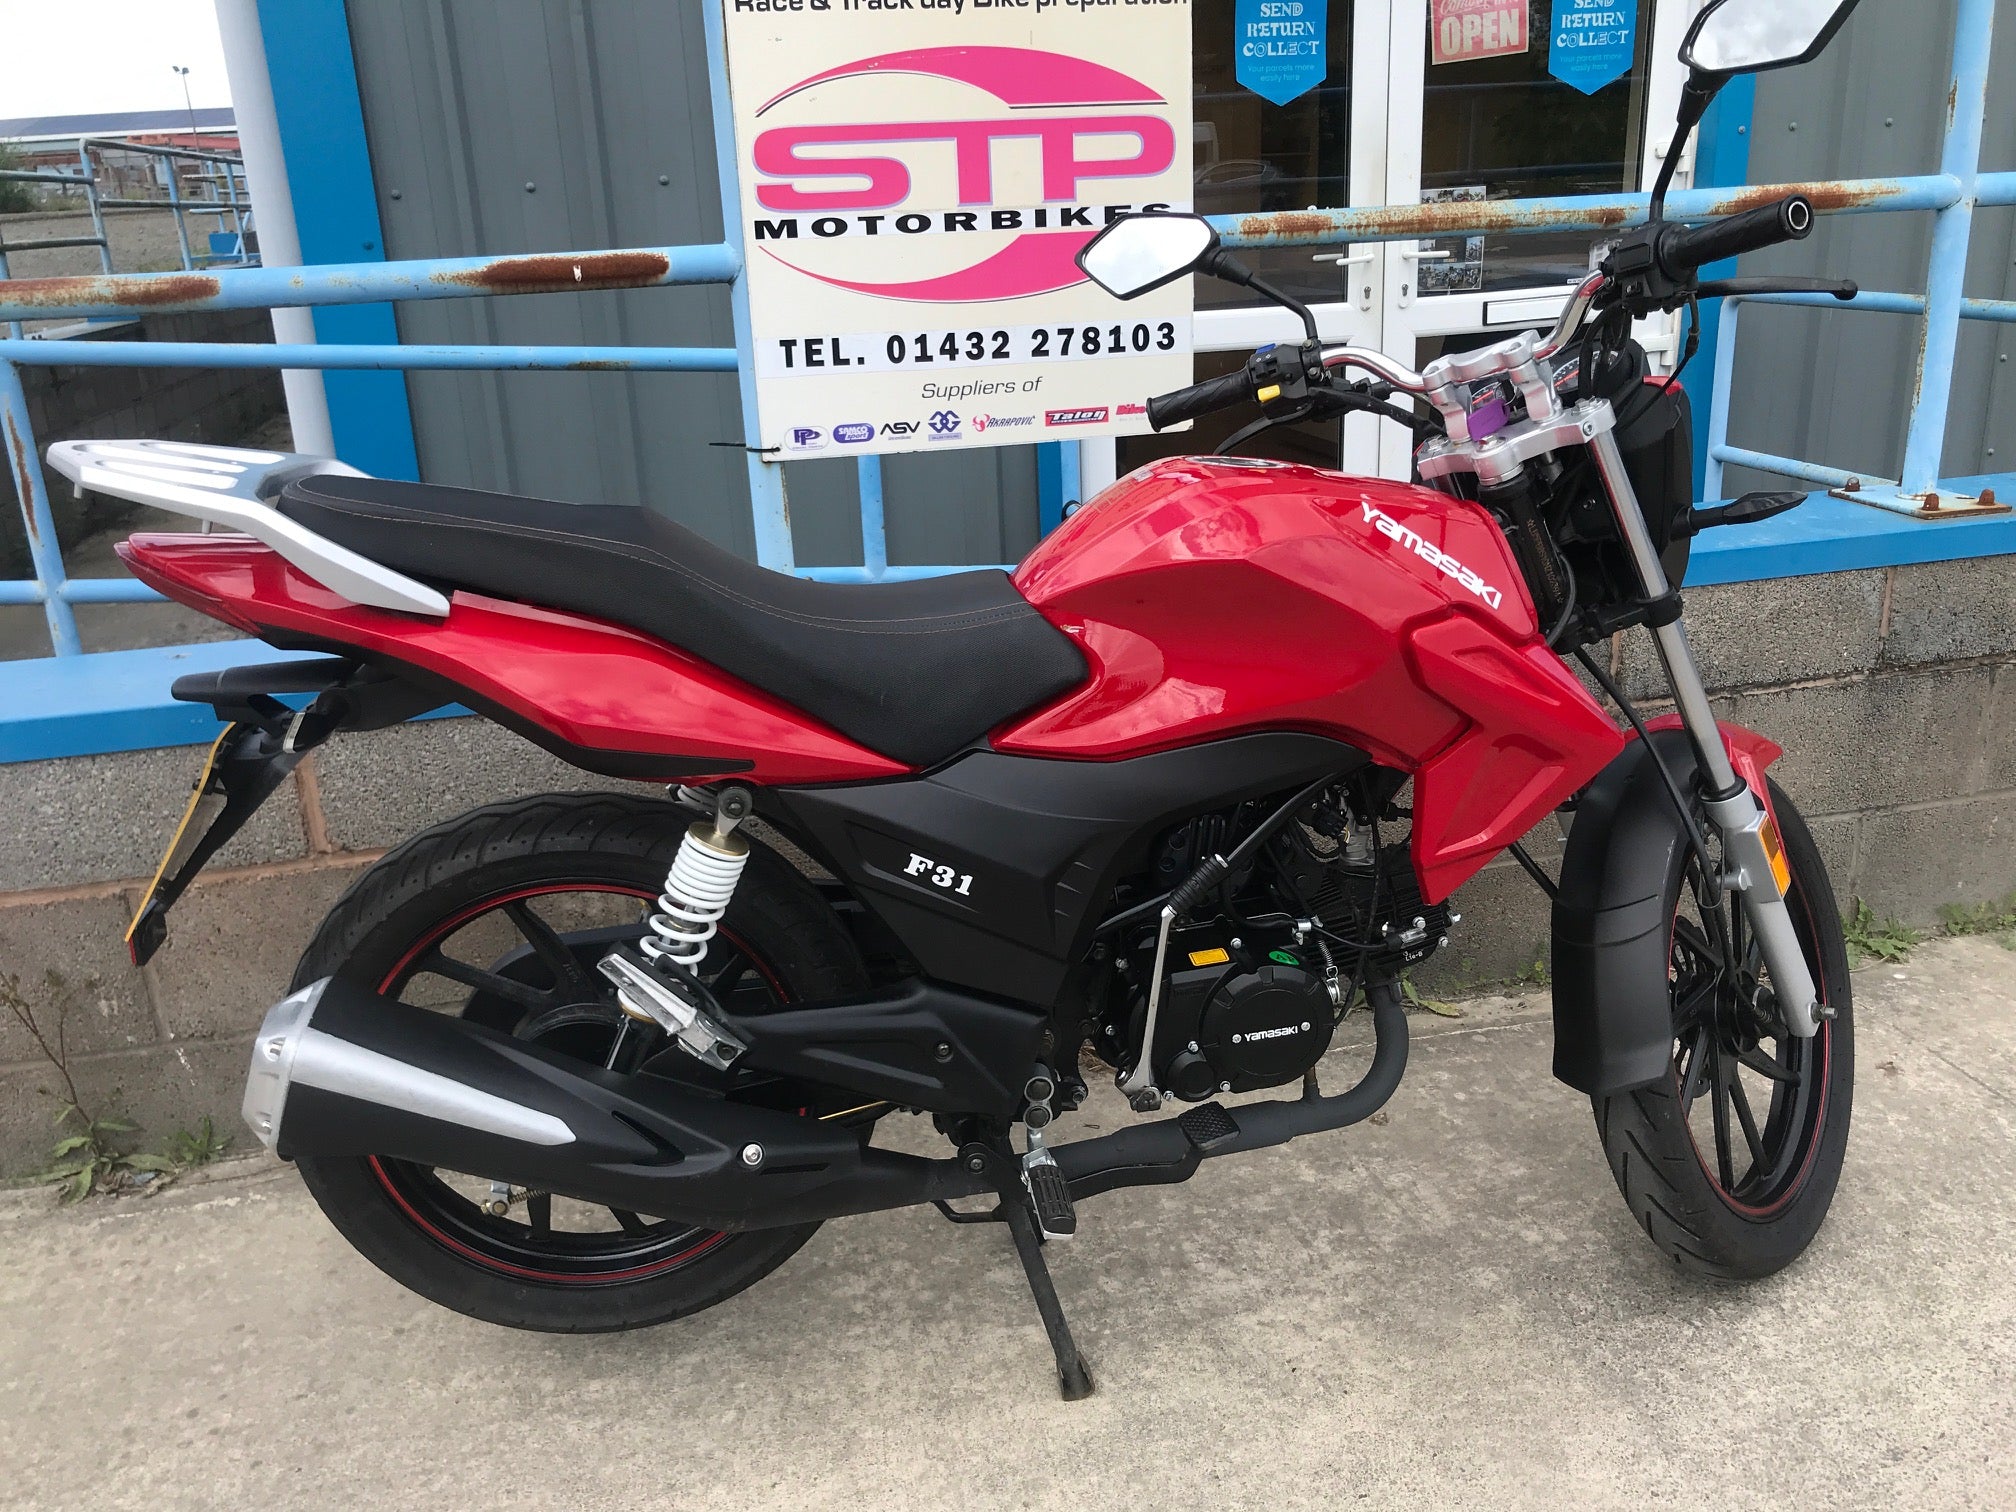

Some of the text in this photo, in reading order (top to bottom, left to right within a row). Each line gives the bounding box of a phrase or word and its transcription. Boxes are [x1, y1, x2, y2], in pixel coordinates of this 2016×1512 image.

[1260, 2, 1304, 18] SEND
[1561, 11, 1627, 28] RETURN
[1246, 21, 1316, 38] RETURN
[1441, 8, 1520, 56] OPEN
[1556, 30, 1630, 48] COLLECT
[1242, 40, 1320, 58] COLLECT
[752, 114, 1176, 214] STP
[779, 322, 1176, 368] TEL. 01432 278103
[921, 376, 1044, 401] Suppliers of
[1047, 409, 1107, 421] Talon
[880, 421, 921, 435] ASV
[903, 853, 975, 896] F31
